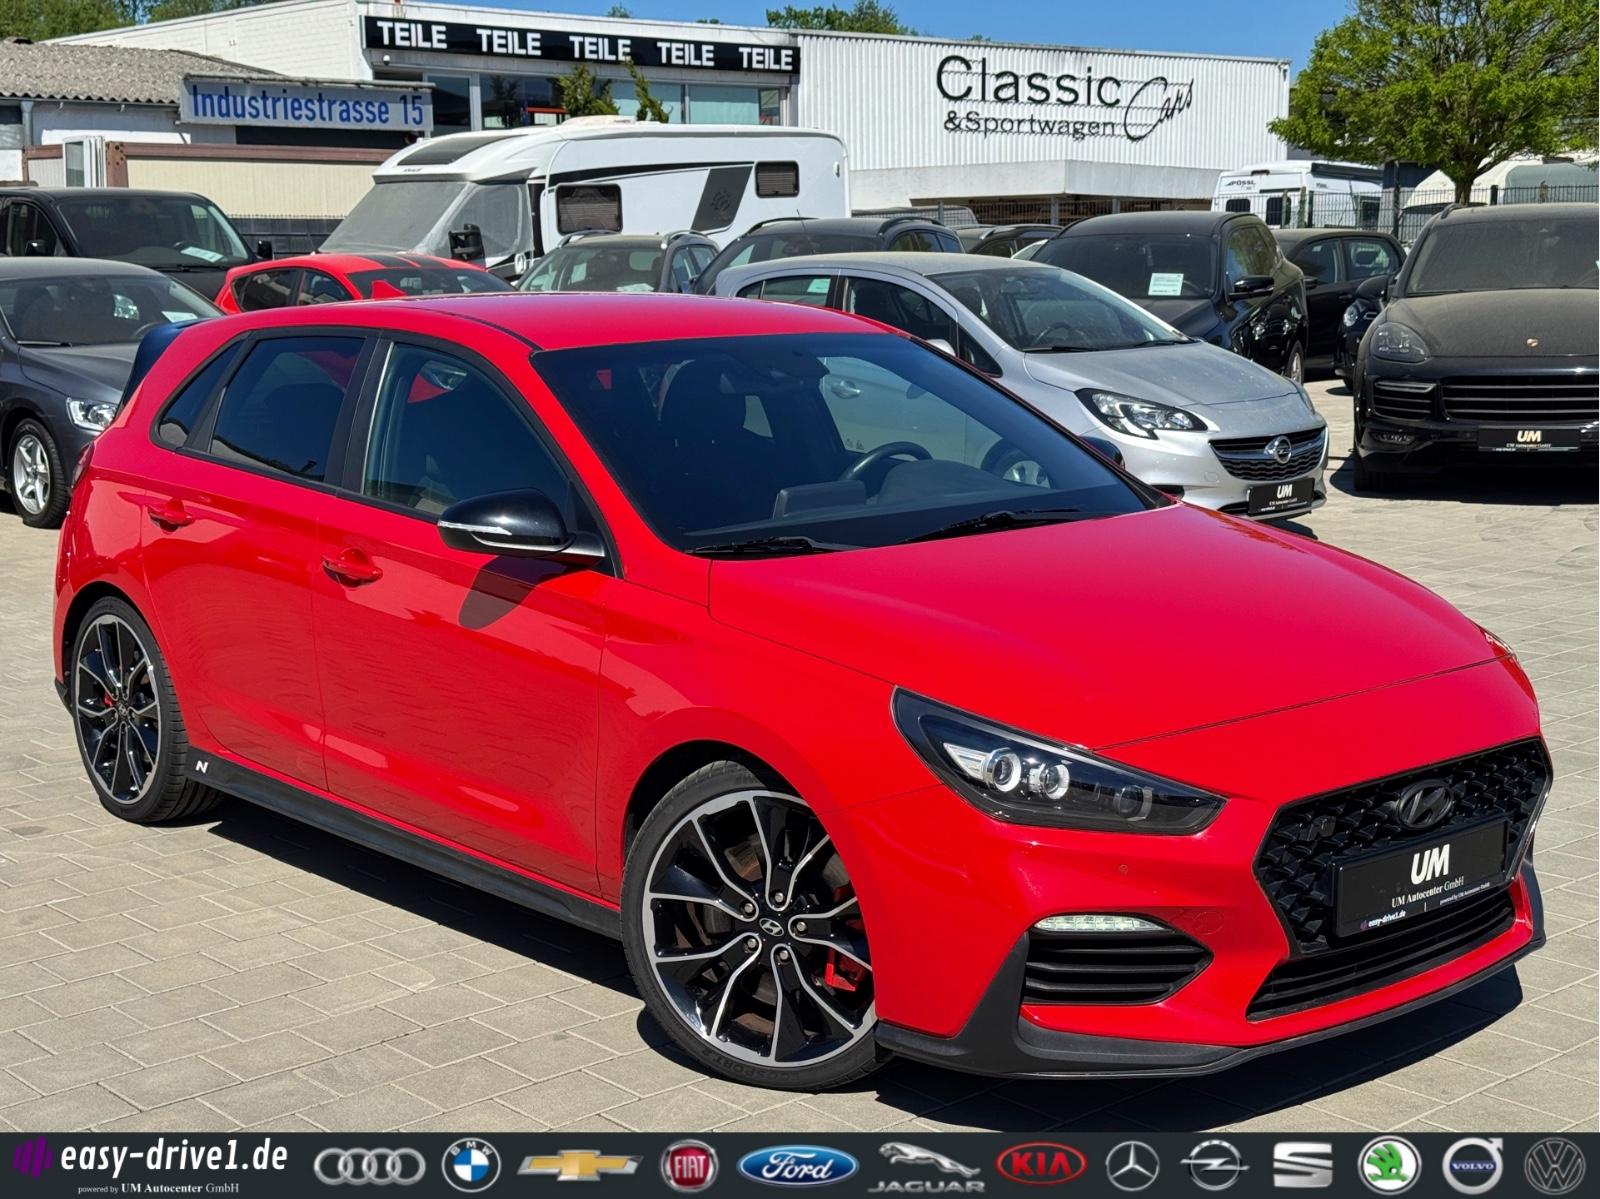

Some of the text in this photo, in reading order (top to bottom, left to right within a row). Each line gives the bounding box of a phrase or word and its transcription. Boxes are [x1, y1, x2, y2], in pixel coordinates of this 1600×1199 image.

[376, 20, 794, 72] TEILE TEILE TEILE TEILE TEILE
[191, 84, 424, 126] Industriestrasse 15
[936, 54, 1195, 142] Classic Cars
[943, 110, 1116, 141] &Sportwagen
[1516, 430, 1542, 442] UM
[1276, 484, 1293, 499] UM
[195, 760, 209, 774] N
[1410, 843, 1450, 885] UM
[1391, 876, 1465, 908] UM Autocenter GmbH
